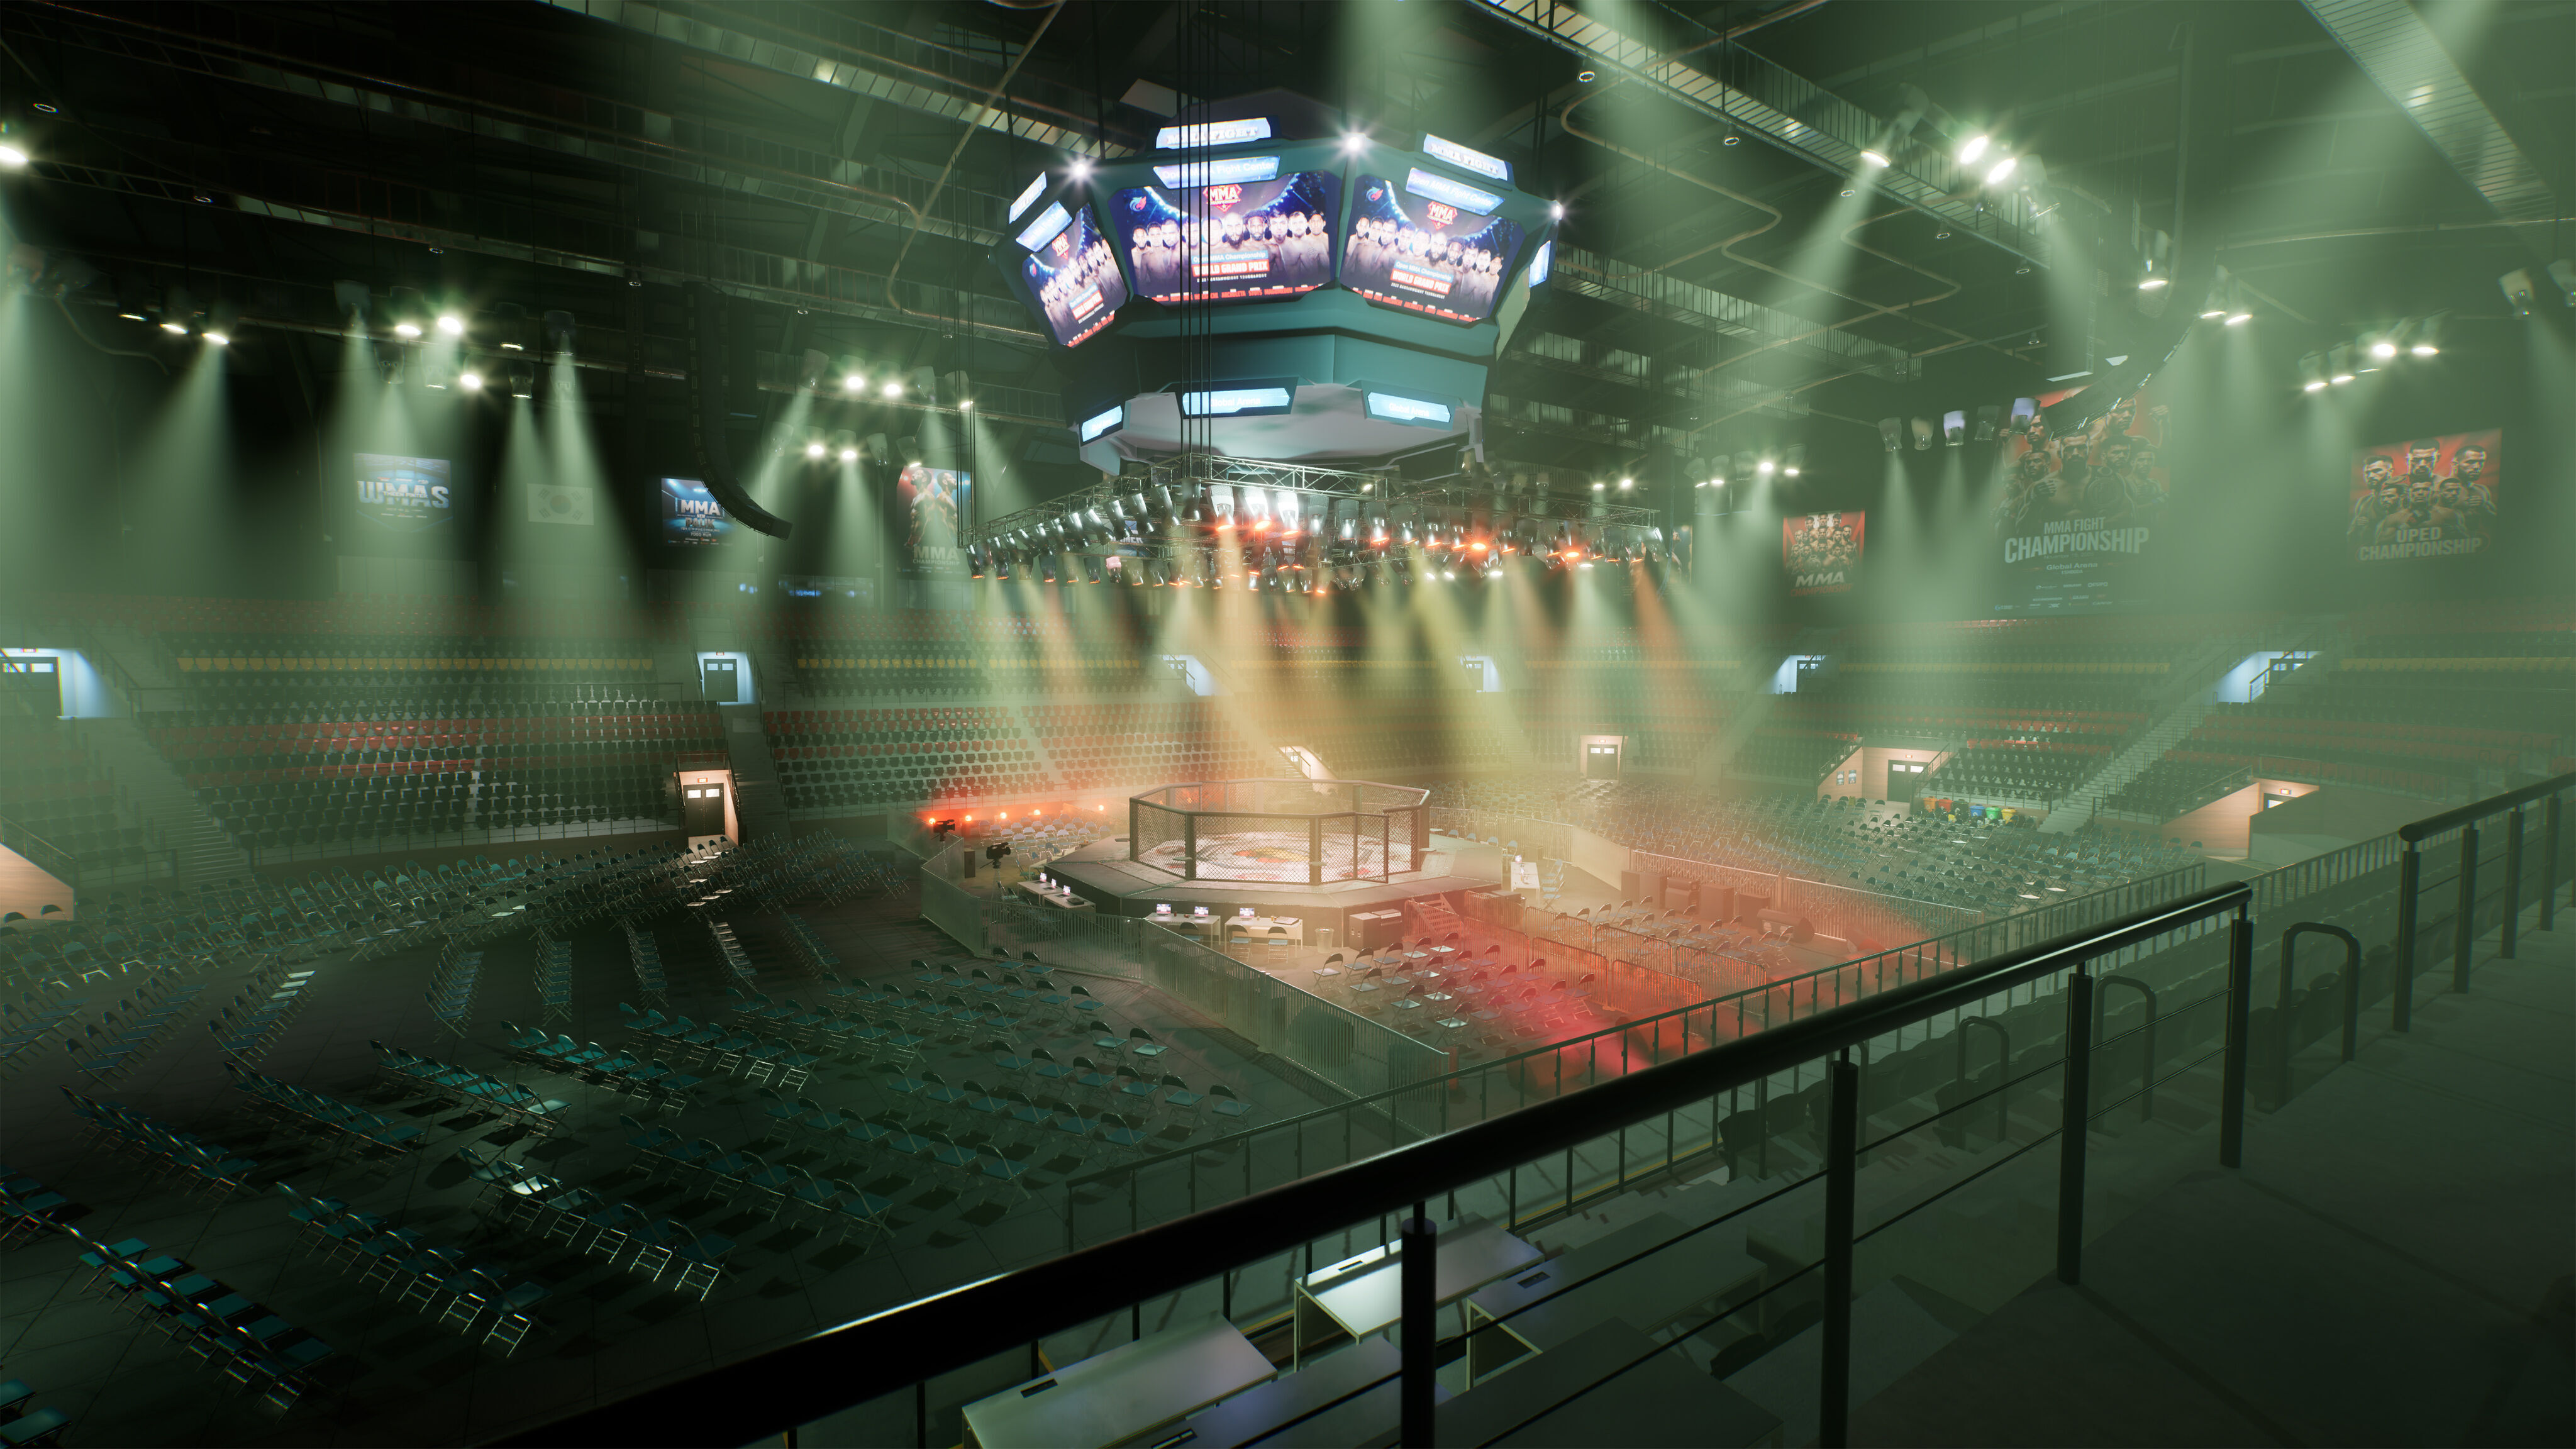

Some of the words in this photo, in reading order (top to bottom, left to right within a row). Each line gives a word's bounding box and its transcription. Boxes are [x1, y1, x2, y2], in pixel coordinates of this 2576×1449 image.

[1209, 126, 1258, 142] FIGHT
[1216, 164, 1241, 176] Fight
[1243, 161, 1275, 172] Center
[1463, 155, 1498, 175] FIGHT
[1409, 173, 1430, 186] Open
[1430, 180, 1451, 193] MMA
[1208, 186, 1239, 202] MMA
[1430, 204, 1453, 222] MMA
[1226, 252, 1266, 260] Championship
[1221, 262, 1248, 274] GRAND
[1248, 260, 1268, 272] PRIX
[1392, 270, 1414, 284] WORLD
[1413, 275, 1435, 289] GRAND
[1434, 281, 1450, 293] PRIX
[1236, 397, 1262, 406] Arena
[681, 499, 721, 516] MMA
[2044, 520, 2072, 535] MMA
[2074, 517, 2106, 532] FIGHT
[2396, 527, 2442, 543] UPED
[914, 546, 960, 560] MMA
[2004, 527, 2150, 564] CHAMPIONSHIP
[2359, 538, 2482, 561] CHAMPIONSHIP
[1796, 571, 1845, 587] MMA
[1790, 584, 1853, 597] CHAMPIONSHIP
